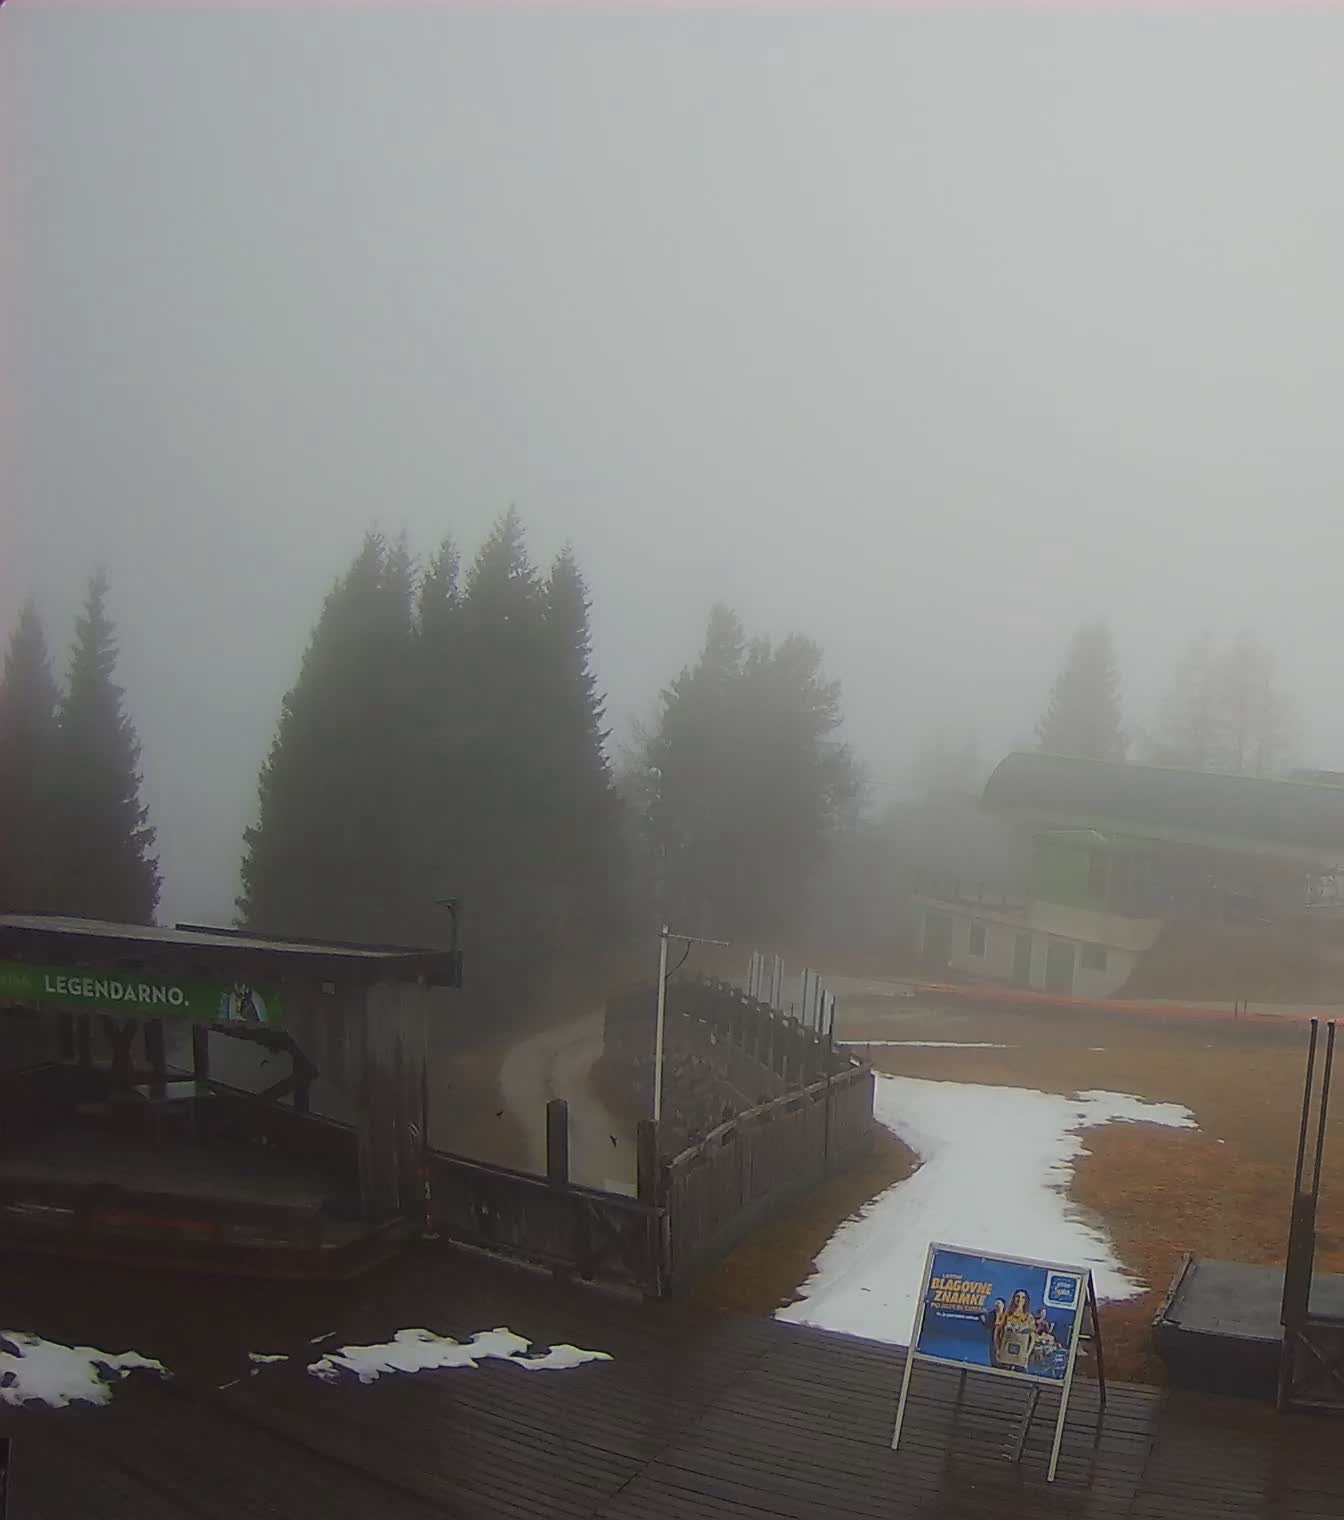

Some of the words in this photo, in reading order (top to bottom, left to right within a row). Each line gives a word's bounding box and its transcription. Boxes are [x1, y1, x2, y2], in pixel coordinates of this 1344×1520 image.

[44, 974, 190, 1007] LEGENDARNO.
[930, 1277, 993, 1295] BLAGOVNE
[933, 1290, 987, 1306] ZNAMKE
